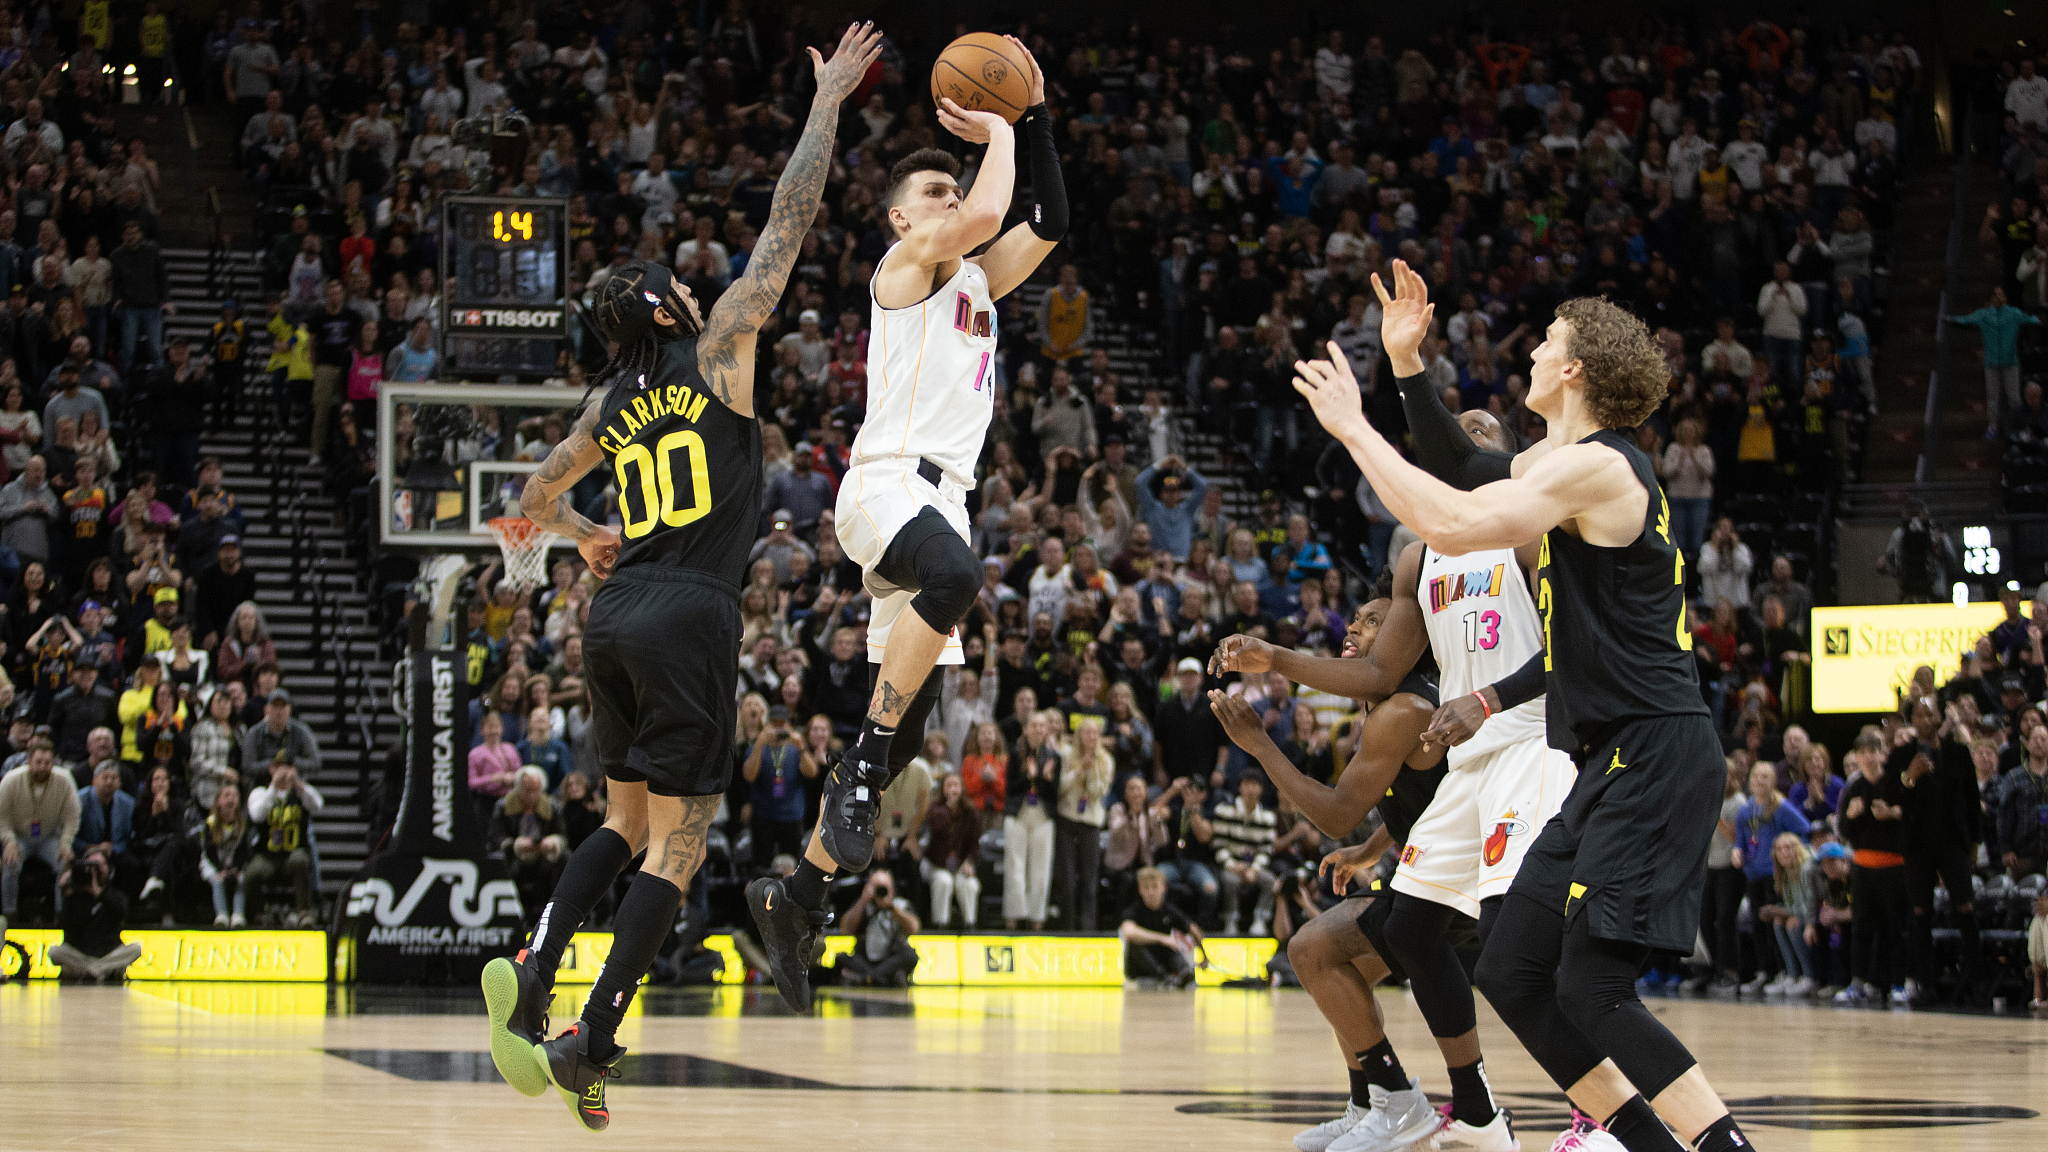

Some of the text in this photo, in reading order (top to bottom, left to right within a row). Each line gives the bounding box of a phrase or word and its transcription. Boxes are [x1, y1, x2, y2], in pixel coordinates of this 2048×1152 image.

[493, 211, 533, 242] 1.4
[481, 309, 562, 328] TISSOT
[973, 351, 994, 401] 1
[599, 384, 709, 454] CLARKSON
[614, 429, 712, 540] 00
[1963, 547, 2000, 575] 123
[1429, 563, 1505, 615] MIAMI
[1462, 609, 1502, 653] 13
[431, 655, 454, 842] AMERICA FIRST
[366, 925, 513, 946] AMERICA FIRST
[166, 937, 299, 979] JENSEN
